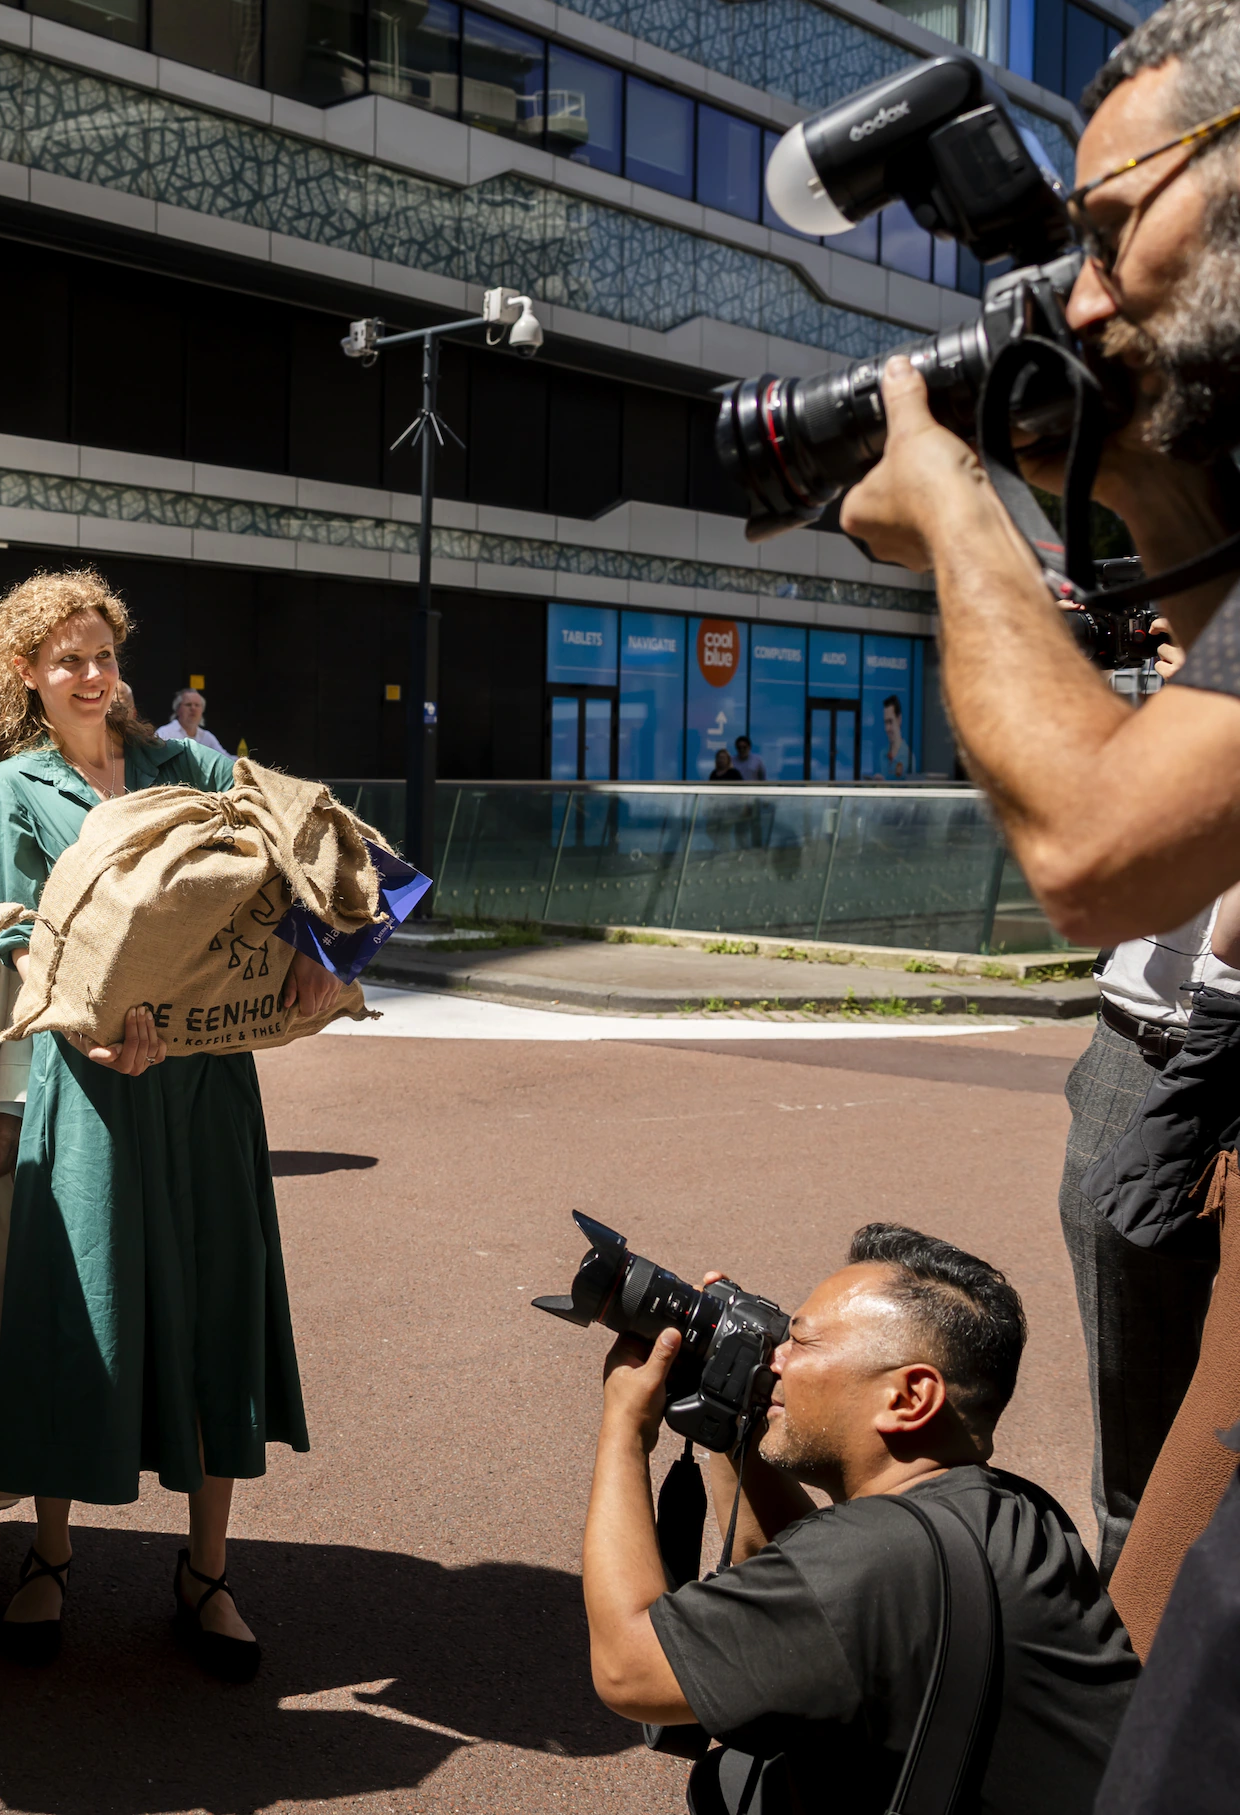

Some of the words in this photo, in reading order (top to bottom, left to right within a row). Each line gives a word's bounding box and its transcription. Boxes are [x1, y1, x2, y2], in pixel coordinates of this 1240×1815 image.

[849, 100, 910, 142] Godox
[561, 629, 603, 647] TABLETS
[627, 634, 678, 653] NAVIGATIE
[703, 630, 733, 649] cool
[703, 648, 733, 667] blue
[753, 645, 802, 662] COMPUTERS
[821, 651, 847, 666] AUDIO
[865, 654, 908, 670] WEARABLES
[185, 1034, 232, 1046] KOFFIE
[238, 1031, 247, 1041] &
[251, 1022, 282, 1039] THEE
